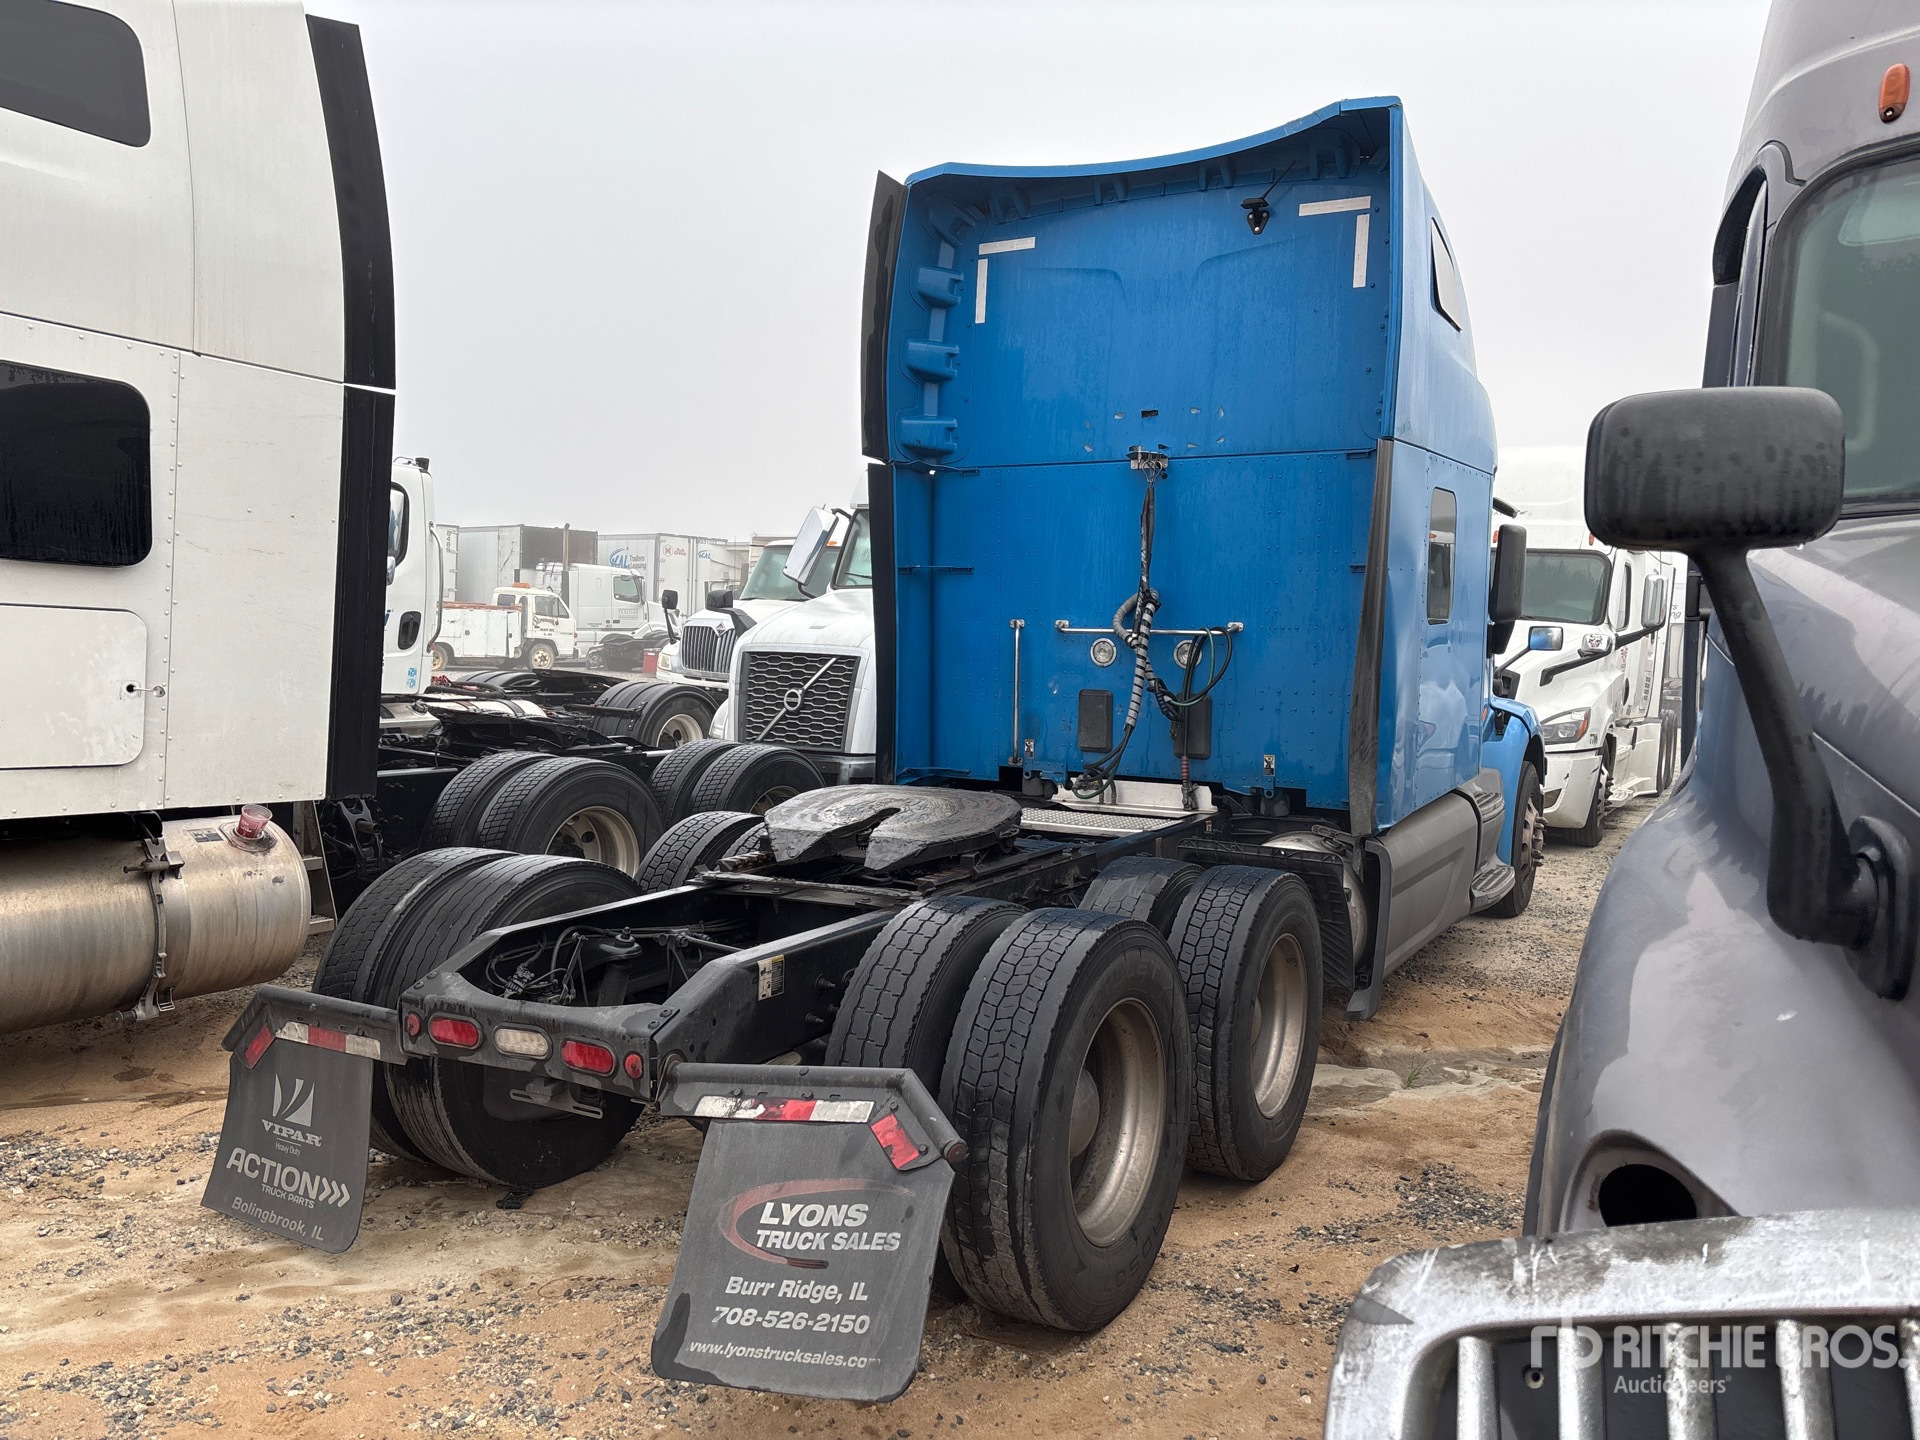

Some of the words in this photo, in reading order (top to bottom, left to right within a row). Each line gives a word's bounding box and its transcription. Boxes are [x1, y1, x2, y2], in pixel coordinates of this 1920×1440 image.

[261, 1118, 321, 1147] VIPAR
[275, 1142, 290, 1154] Heavy
[289, 1145, 301, 1158] Duty
[226, 1147, 321, 1200] ACTION
[261, 1184, 287, 1200] TRUCK
[287, 1194, 315, 1209] PARTS
[231, 1196, 307, 1236] Bolingbrook,
[311, 1225, 324, 1242] IL
[759, 1201, 869, 1228] LYONS
[756, 1229, 830, 1250] TRUCK
[831, 1231, 902, 1252] SALES
[724, 1276, 775, 1297] Burr
[777, 1279, 843, 1305] Ridge,
[848, 1281, 869, 1301] IL
[711, 1306, 871, 1335] 708-526-2150
